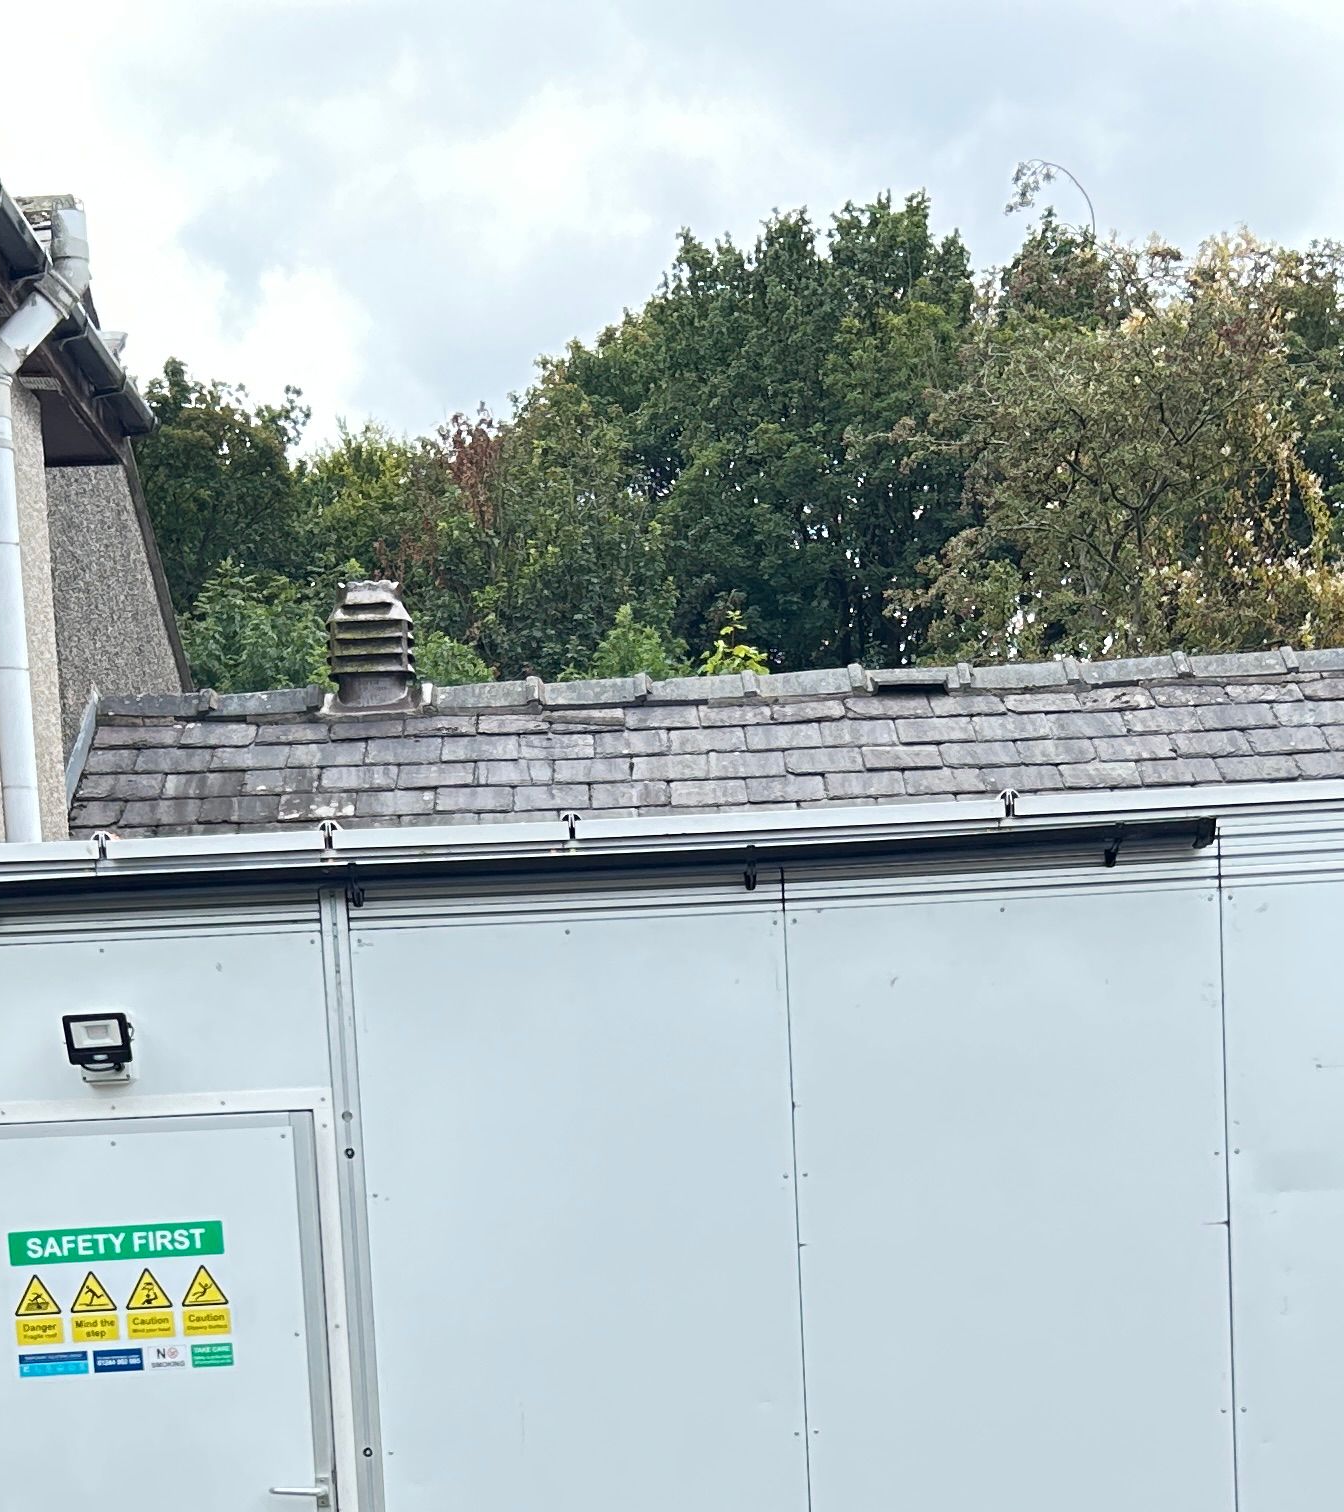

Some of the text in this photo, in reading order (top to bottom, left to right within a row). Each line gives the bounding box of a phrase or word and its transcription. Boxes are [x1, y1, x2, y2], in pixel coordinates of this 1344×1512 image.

[26, 1228, 205, 1259] SAFETY FIRST
[75, 1318, 116, 1328] Mind the
[132, 1316, 169, 1326] Caution
[188, 1313, 225, 1323] Caution
[22, 1323, 56, 1333] Danger
[86, 1329, 107, 1339] step
